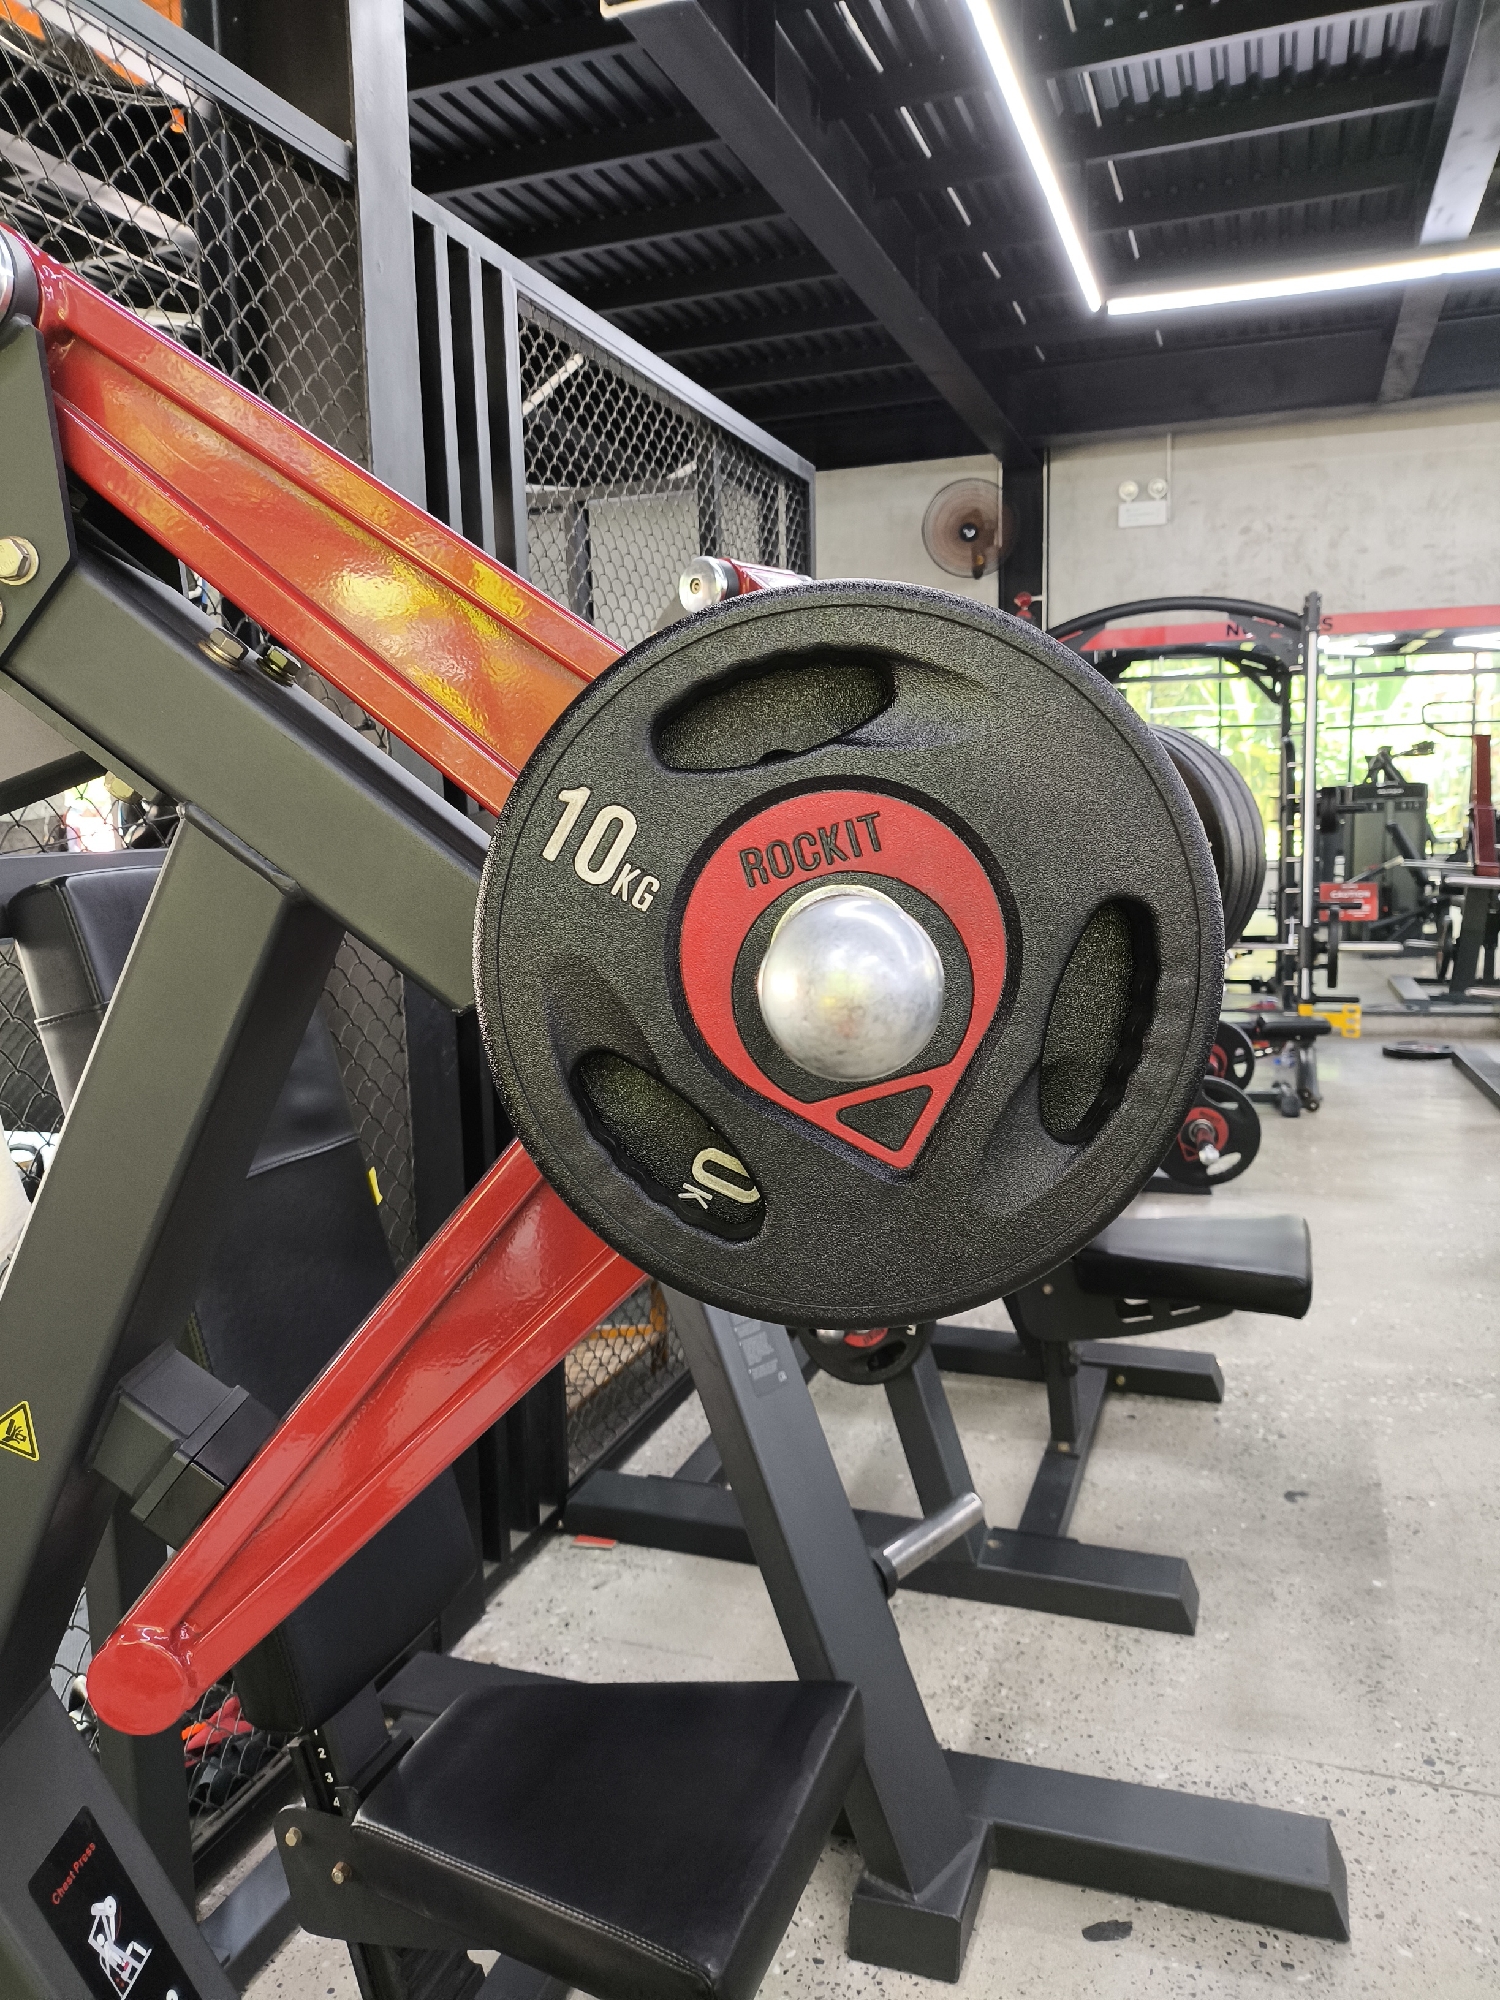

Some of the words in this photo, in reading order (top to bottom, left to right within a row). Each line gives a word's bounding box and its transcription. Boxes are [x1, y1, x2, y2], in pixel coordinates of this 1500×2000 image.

[739, 811, 882, 888] ROCKIT
[317, 1747, 327, 1759] 2
[324, 1771, 334, 1783] 3
[333, 1796, 340, 1807] 4
[51, 1870, 76, 1905] Chest
[73, 1842, 96, 1874] Press
